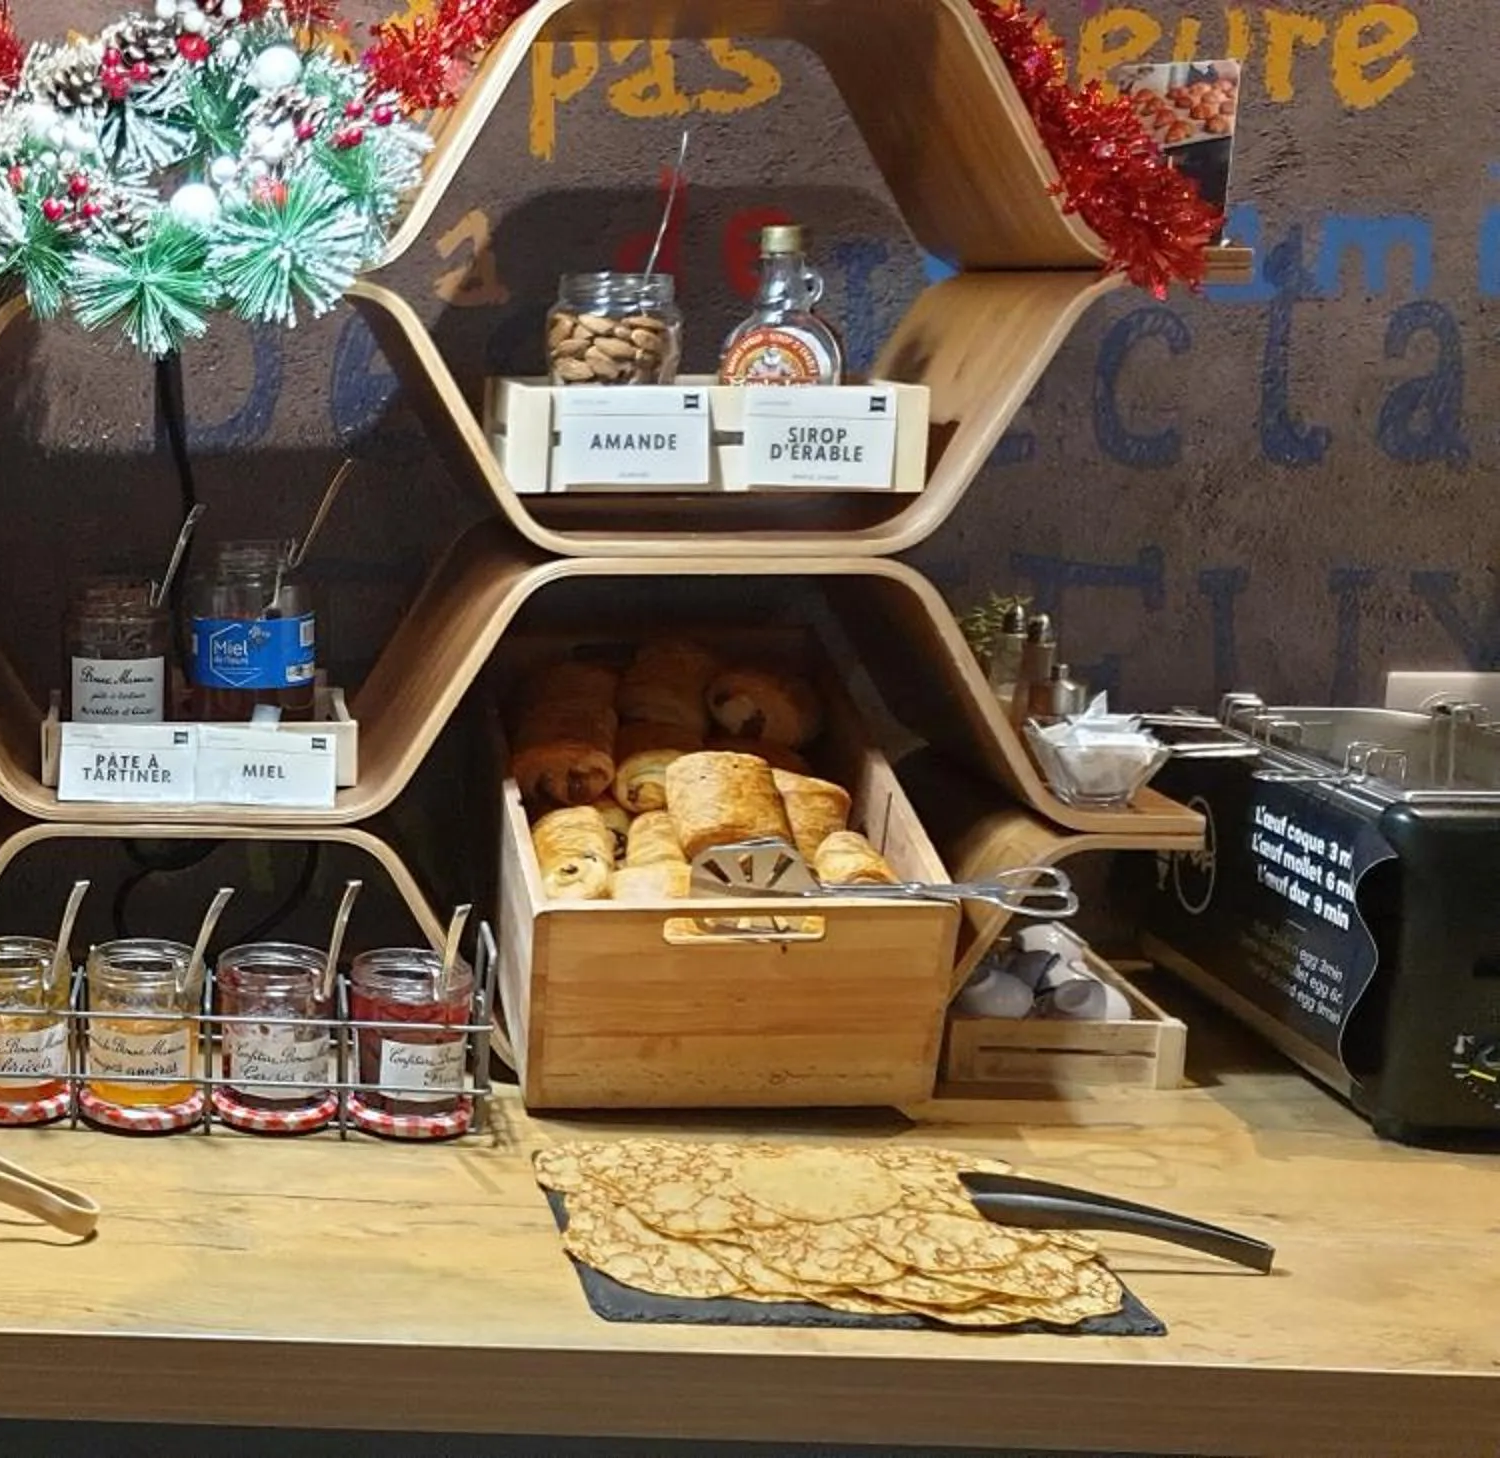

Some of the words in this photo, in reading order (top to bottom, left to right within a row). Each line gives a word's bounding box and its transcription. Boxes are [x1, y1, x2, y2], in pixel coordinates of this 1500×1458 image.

[590, 433, 677, 450] AMANDE
[787, 427, 847, 443] SIROP
[214, 640, 248, 657] Miel
[82, 767, 173, 783] TARTINER
[242, 764, 285, 779] MIEL
[1328, 841, 1339, 863] 3
[1325, 871, 1336, 892] 6
[1288, 879, 1311, 908] dur
[1313, 894, 1323, 916] 9
[1323, 902, 1350, 931] min
